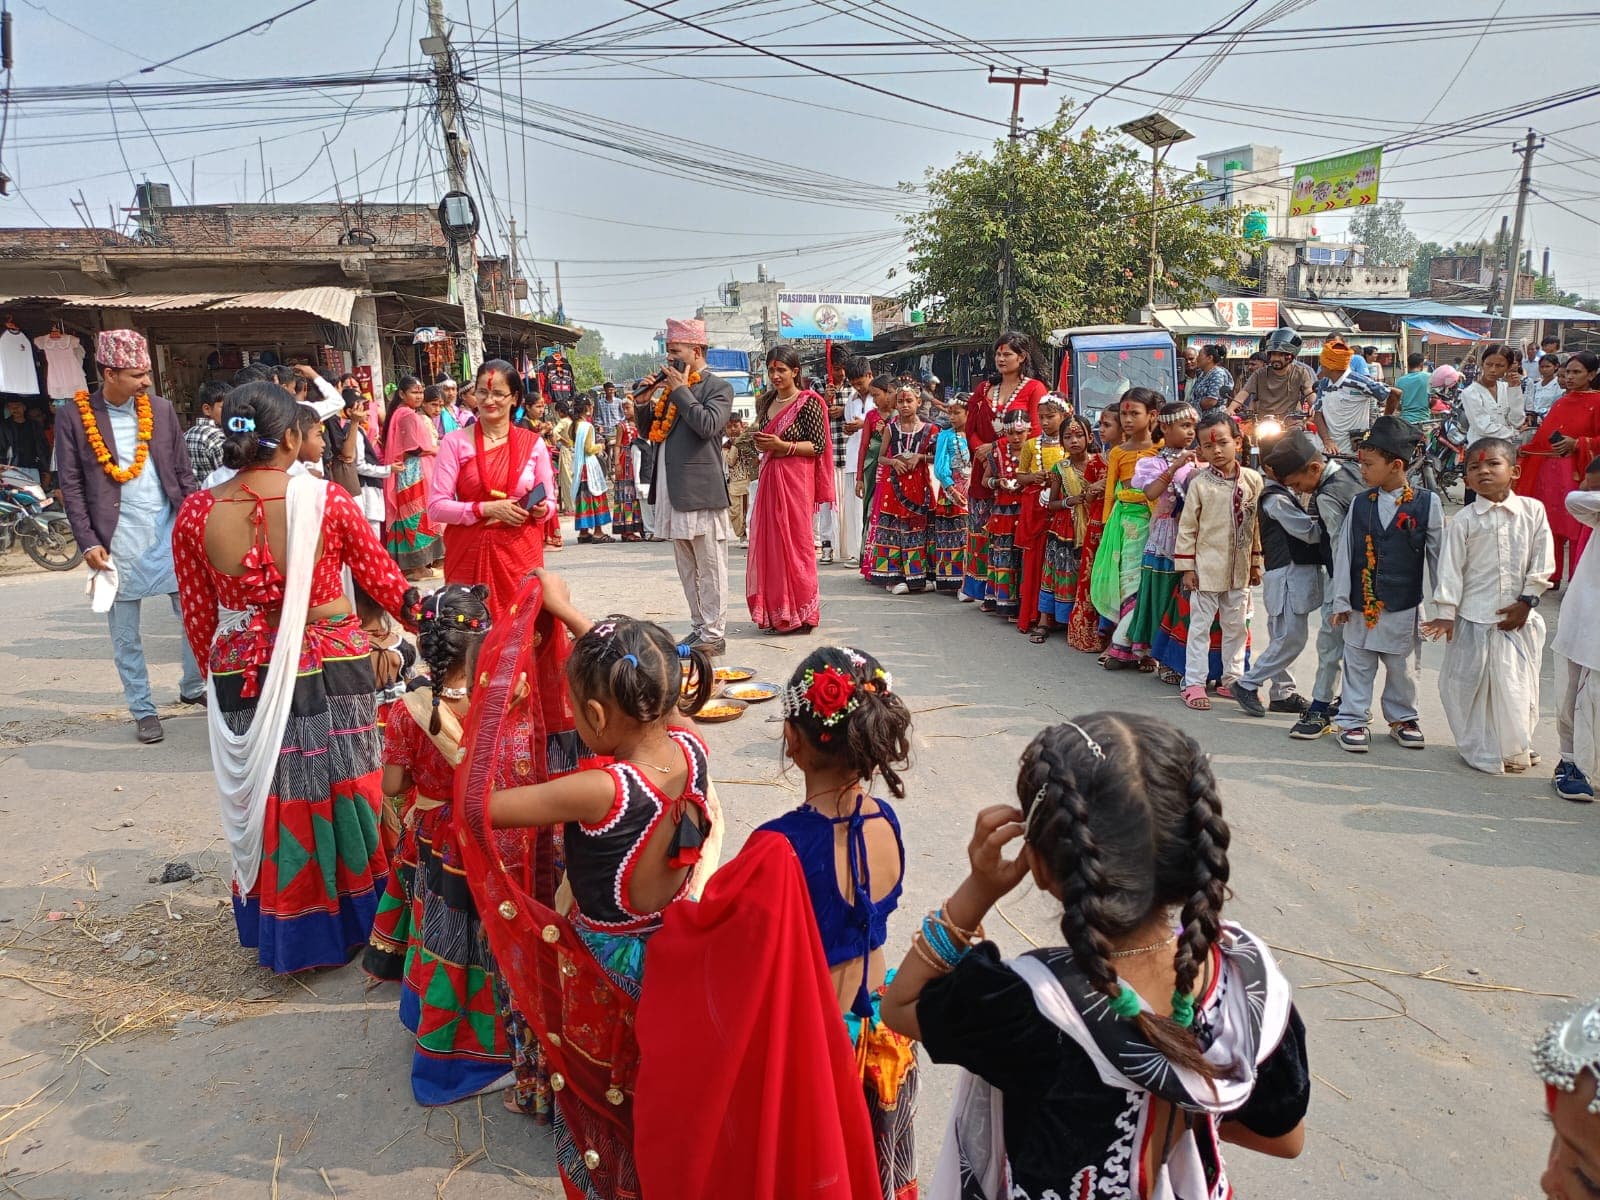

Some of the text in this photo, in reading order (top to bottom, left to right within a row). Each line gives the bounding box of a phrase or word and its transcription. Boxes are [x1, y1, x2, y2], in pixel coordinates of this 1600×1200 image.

[778, 293, 871, 305] PRASIDDHA VIDHYA NIKETAN
